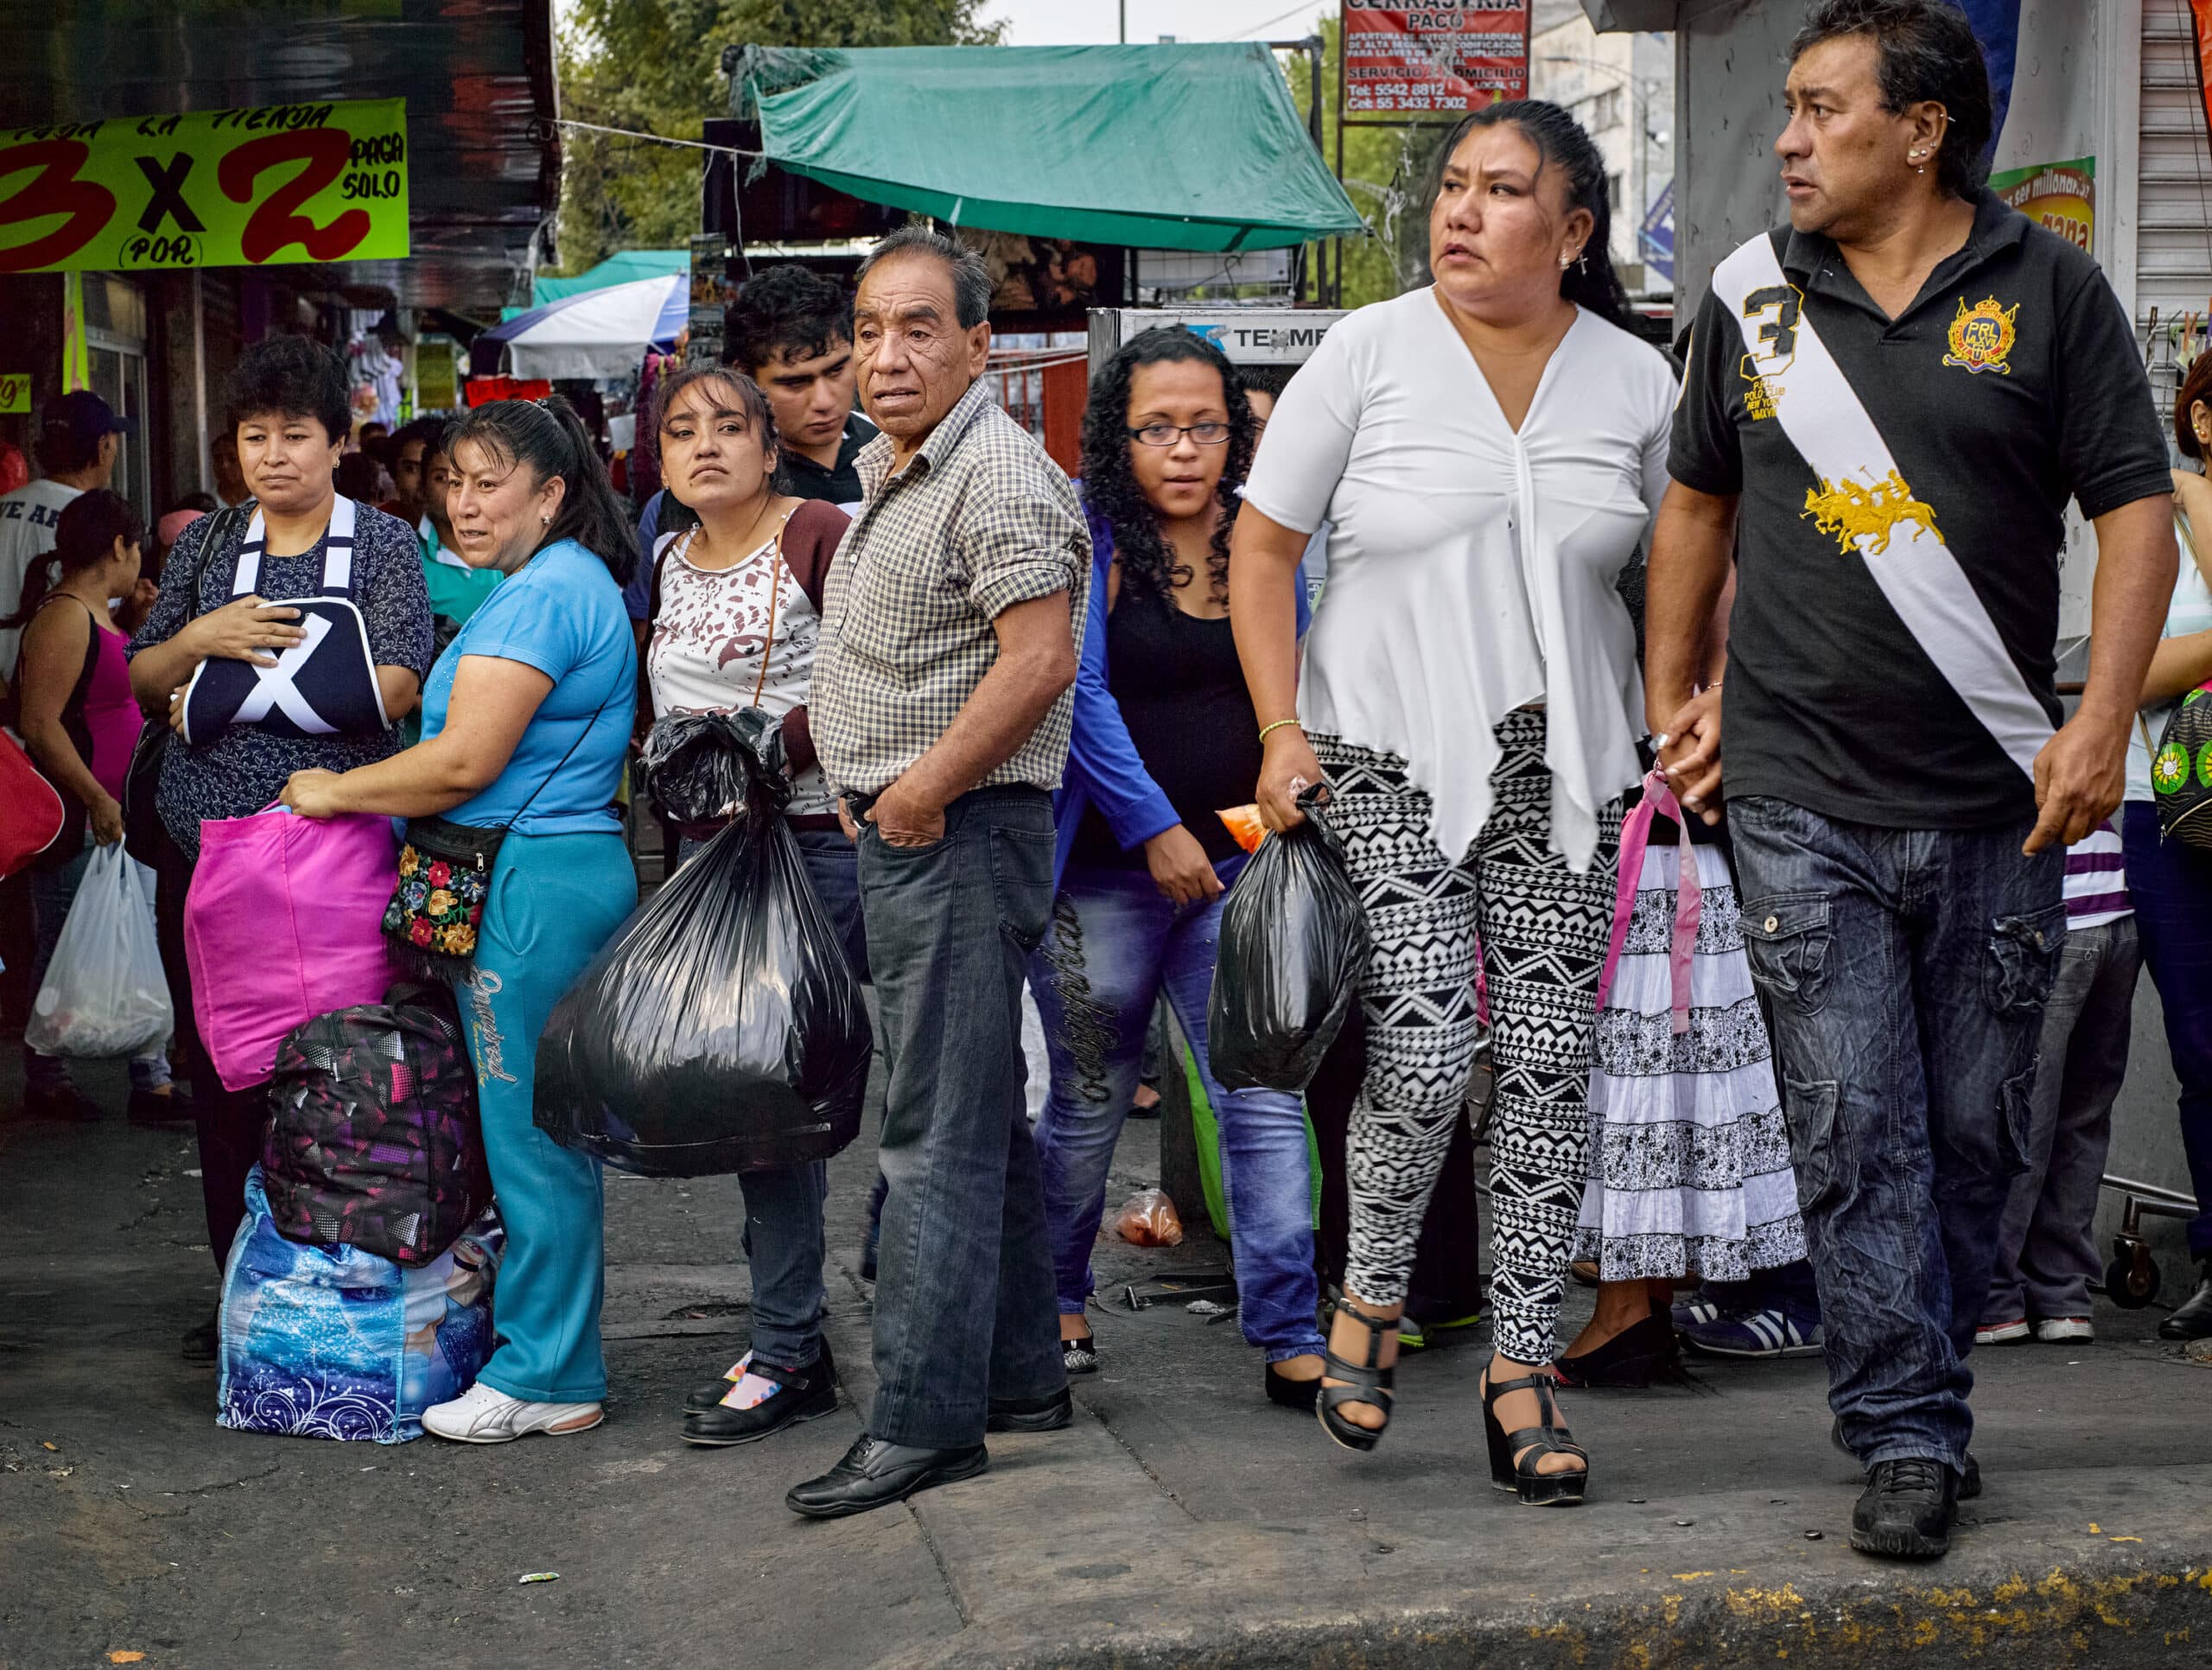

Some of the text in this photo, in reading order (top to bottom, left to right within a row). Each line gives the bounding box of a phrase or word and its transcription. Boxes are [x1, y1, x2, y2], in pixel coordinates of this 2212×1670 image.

[1408, 14, 1463, 29] PACO
[1349, 67, 1422, 79] SERVICIO
[1349, 83, 1446, 96] Tel: 5542 8812
[1348, 97, 1467, 110] Cel: 55 3432 7302
[137, 114, 182, 137] LA
[212, 103, 334, 130] TIENDA
[351, 131, 404, 166] PAGA
[341, 171, 401, 200] SOLO
[2015, 181, 2031, 206] ser
[0, 127, 372, 274] 3 X 2
[118, 233, 203, 268] (POR)
[1739, 283, 1805, 381] 3
[1967, 321, 1999, 338] PRL
